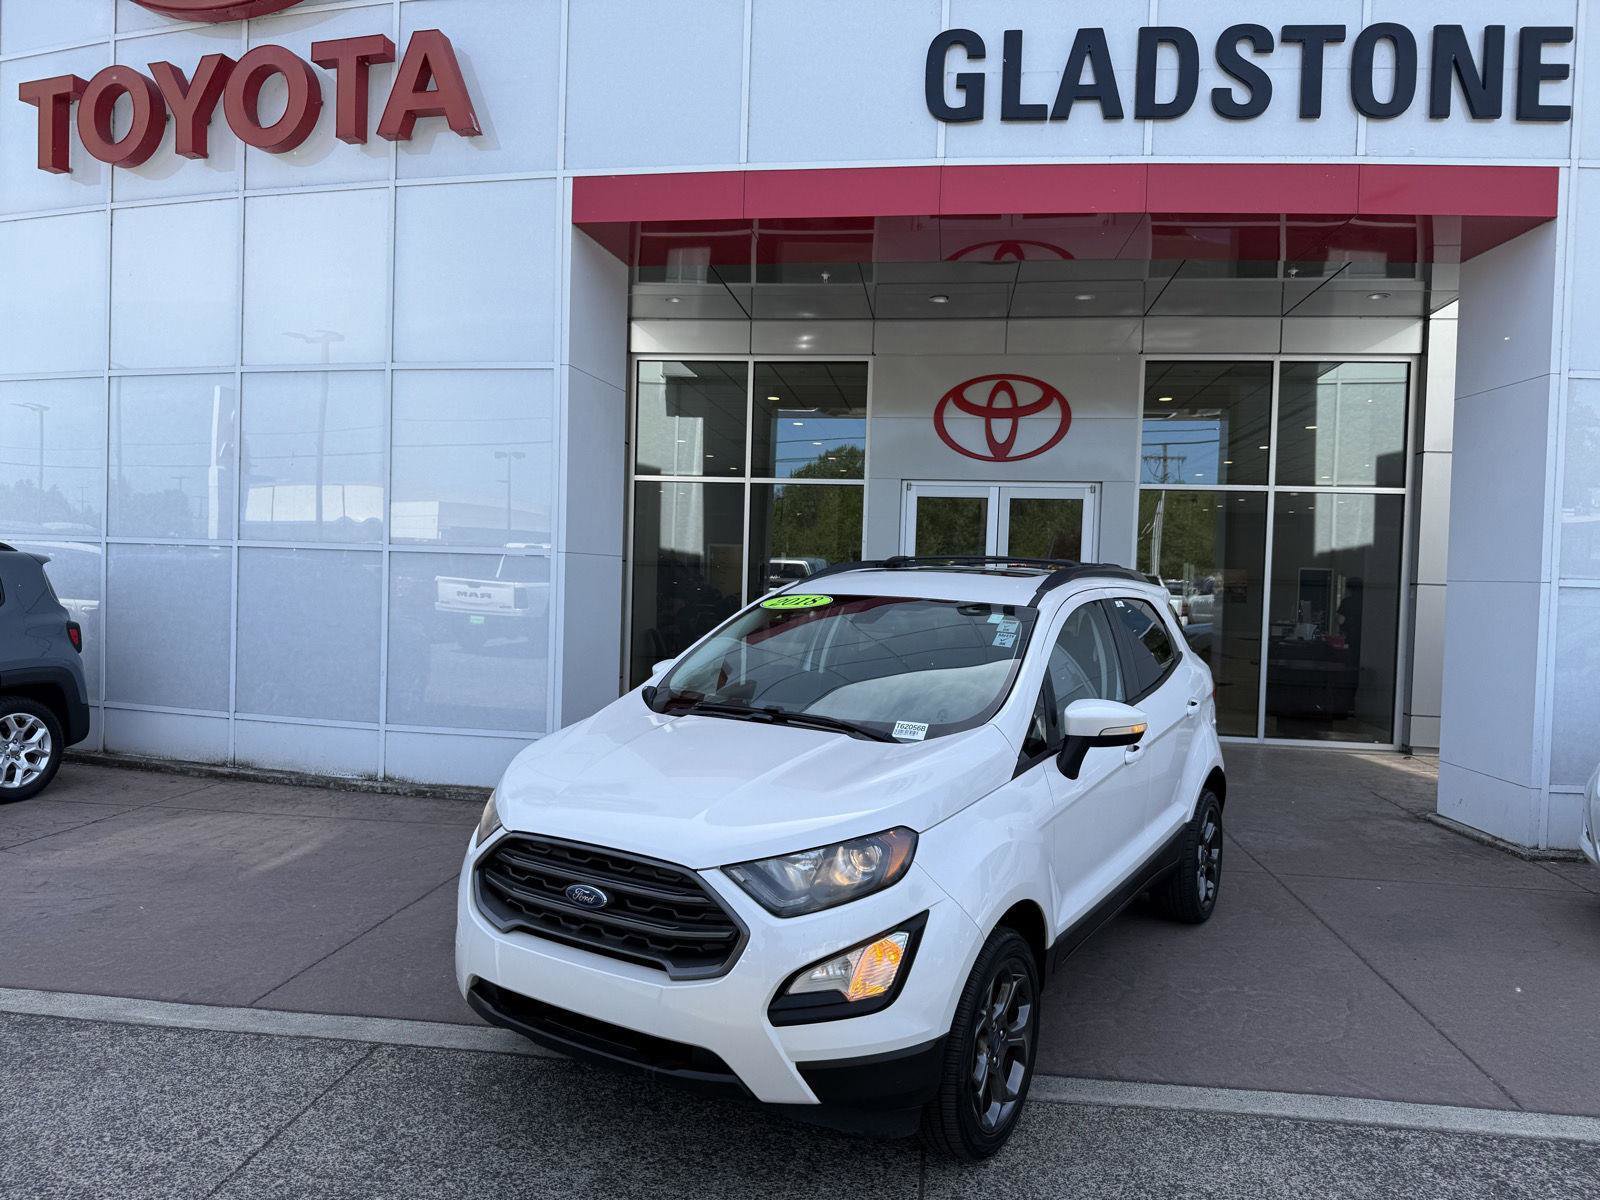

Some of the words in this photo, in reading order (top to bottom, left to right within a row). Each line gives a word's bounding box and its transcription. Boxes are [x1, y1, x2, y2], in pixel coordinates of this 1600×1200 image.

[19, 29, 482, 174] TOYOTA
[925, 22, 1573, 123] GLADSTONE
[766, 596, 824, 606] 2018
[572, 887, 596, 903] Ford
